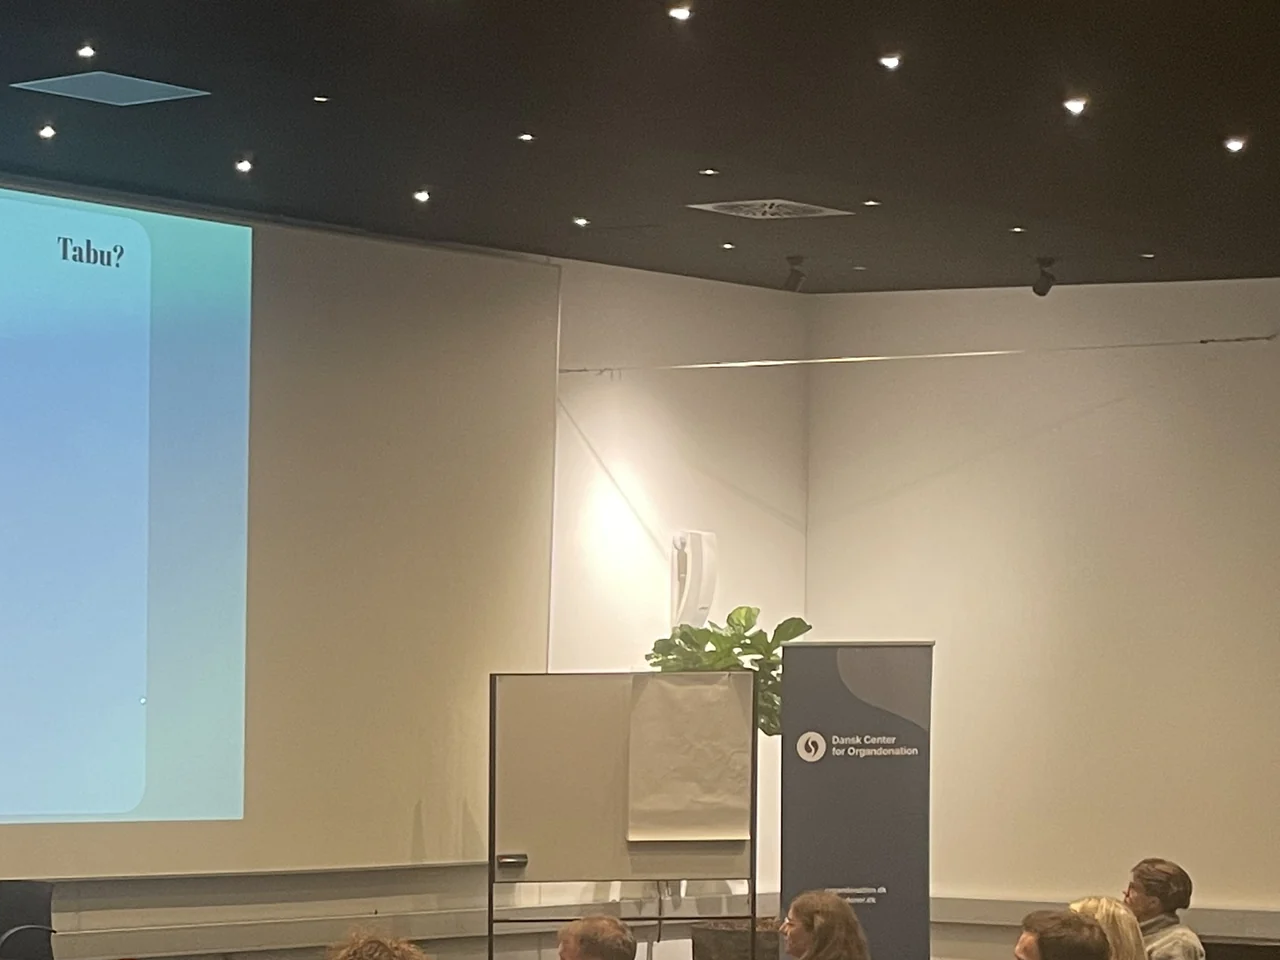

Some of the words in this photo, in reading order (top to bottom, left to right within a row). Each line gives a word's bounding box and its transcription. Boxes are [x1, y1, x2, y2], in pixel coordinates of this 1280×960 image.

[57, 236, 125, 268] Tabu?
[832, 735, 862, 745] Dansk
[863, 735, 896, 744] Center
[832, 747, 845, 756] for
[847, 746, 919, 758] Organdonation
